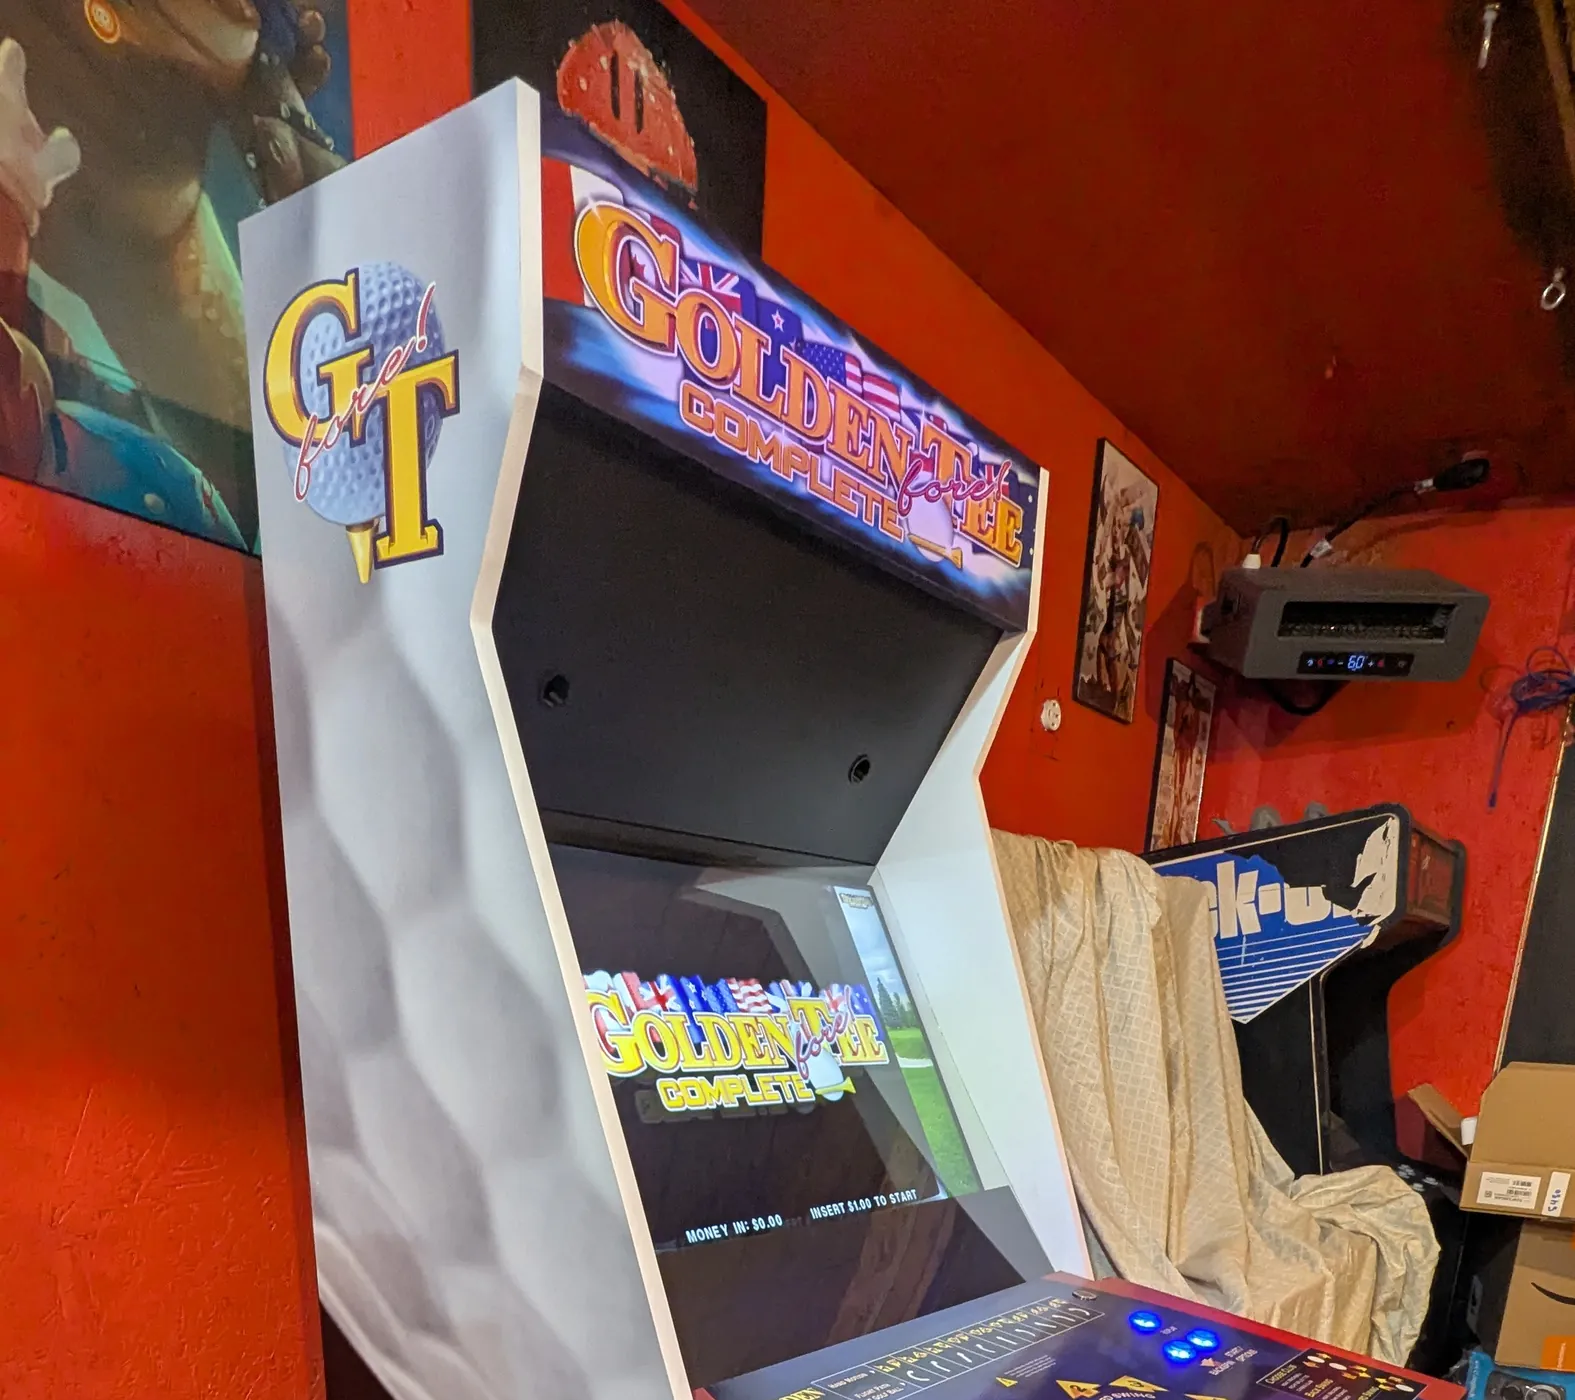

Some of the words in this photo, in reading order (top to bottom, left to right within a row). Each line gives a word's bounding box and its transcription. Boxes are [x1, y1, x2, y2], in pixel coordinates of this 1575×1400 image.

[574, 200, 914, 492] GOLDEN
[919, 420, 1024, 568] TEE
[679, 380, 904, 542] COMPLETE
[585, 990, 800, 1076] GOLDEN
[788, 996, 890, 1067] TEE
[657, 1072, 815, 1111] COMPLETE
[685, 1224, 728, 1244] MONEY
[733, 1219, 750, 1235] IN:
[751, 1214, 783, 1232] $0.00
[810, 1202, 846, 1220] INSERT
[848, 1198, 872, 1213] $1.00
[873, 1195, 887, 1208] TO
[889, 1188, 918, 1205] START
